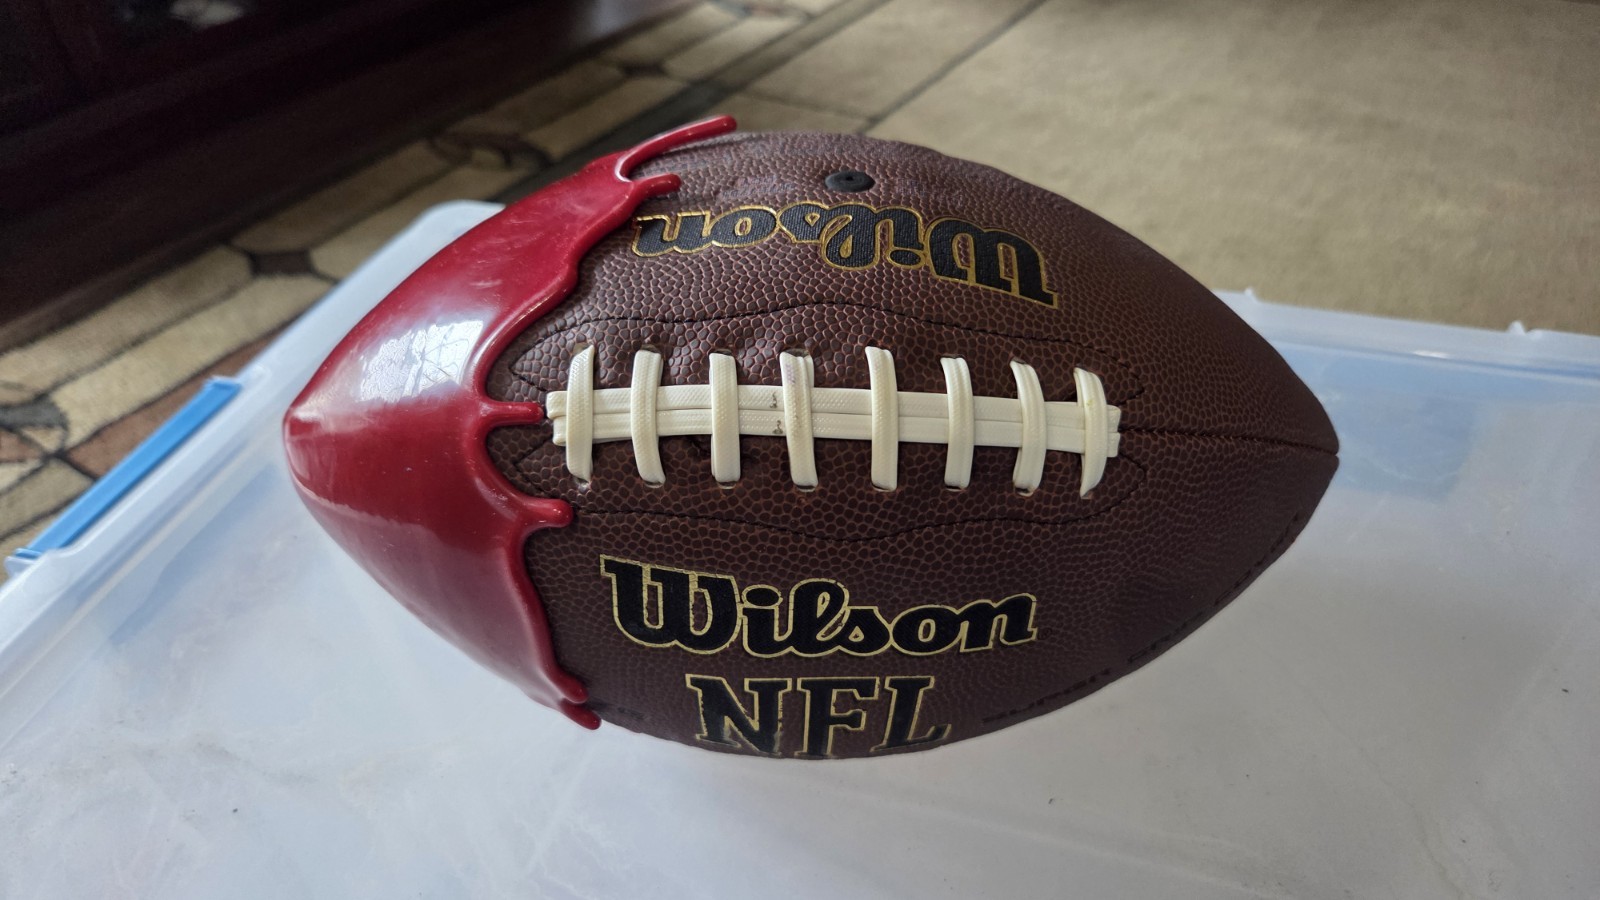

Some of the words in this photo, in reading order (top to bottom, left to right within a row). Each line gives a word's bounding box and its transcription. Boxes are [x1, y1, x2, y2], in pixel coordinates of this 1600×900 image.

[631, 201, 1058, 309] Wilson
[599, 554, 1038, 658] Wilson
[684, 673, 952, 759] NFL
